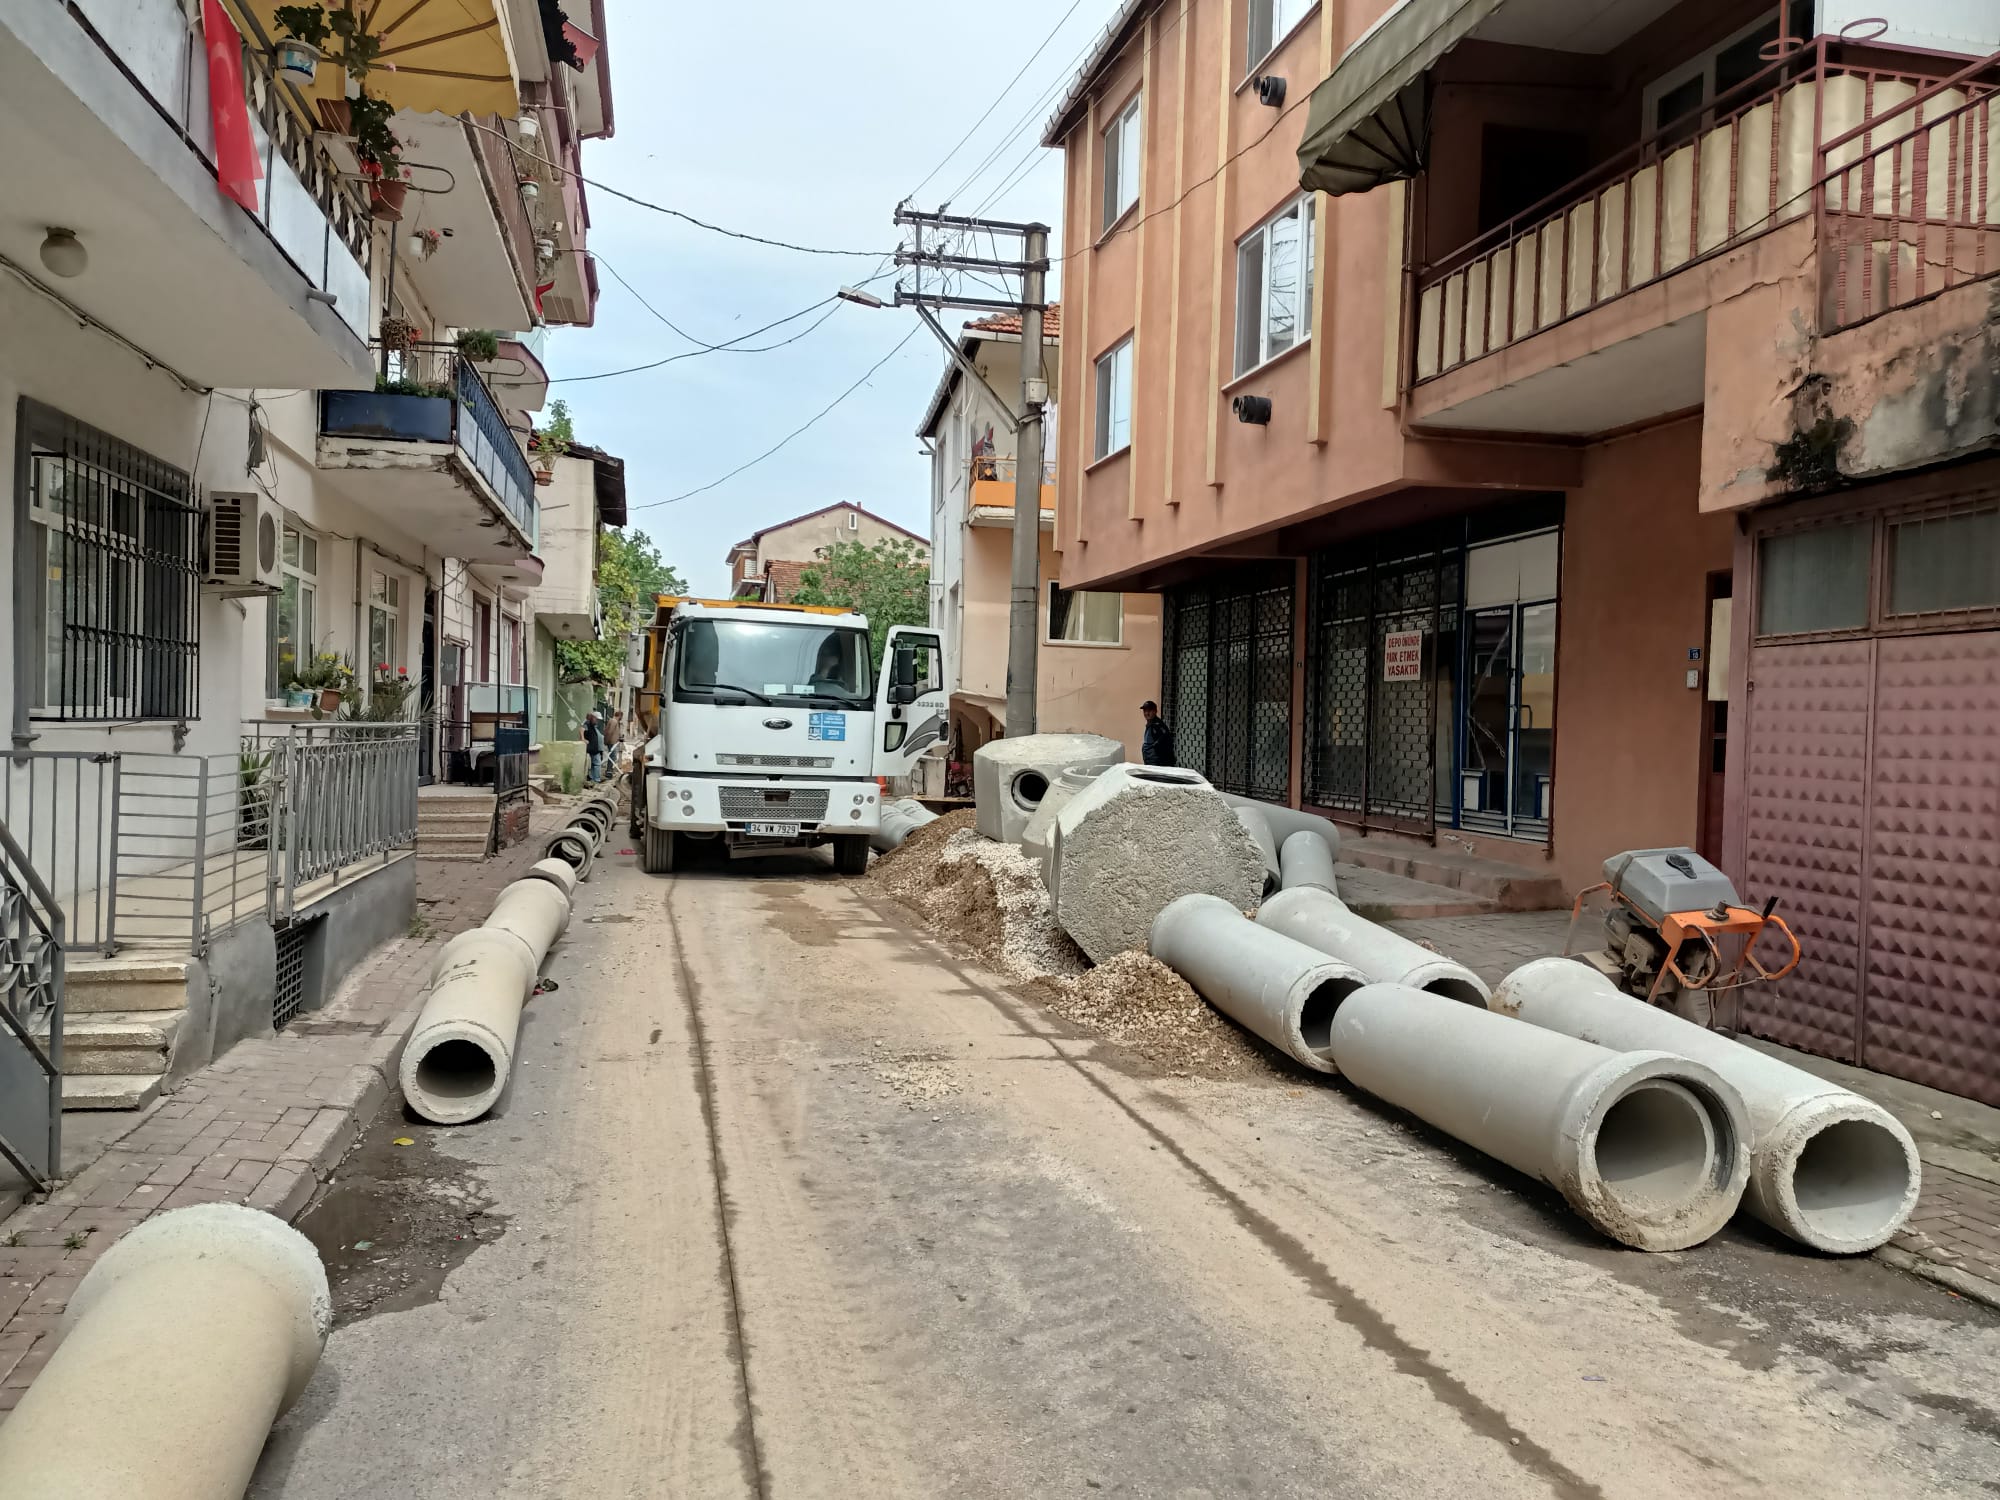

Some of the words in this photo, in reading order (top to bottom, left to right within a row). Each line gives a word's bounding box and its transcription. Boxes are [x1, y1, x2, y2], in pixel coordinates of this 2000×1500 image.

[1388, 637, 1401, 648] DEPO
[1399, 650, 1419, 662] ETMEK
[1387, 664, 1419, 677] YASAKTIR
